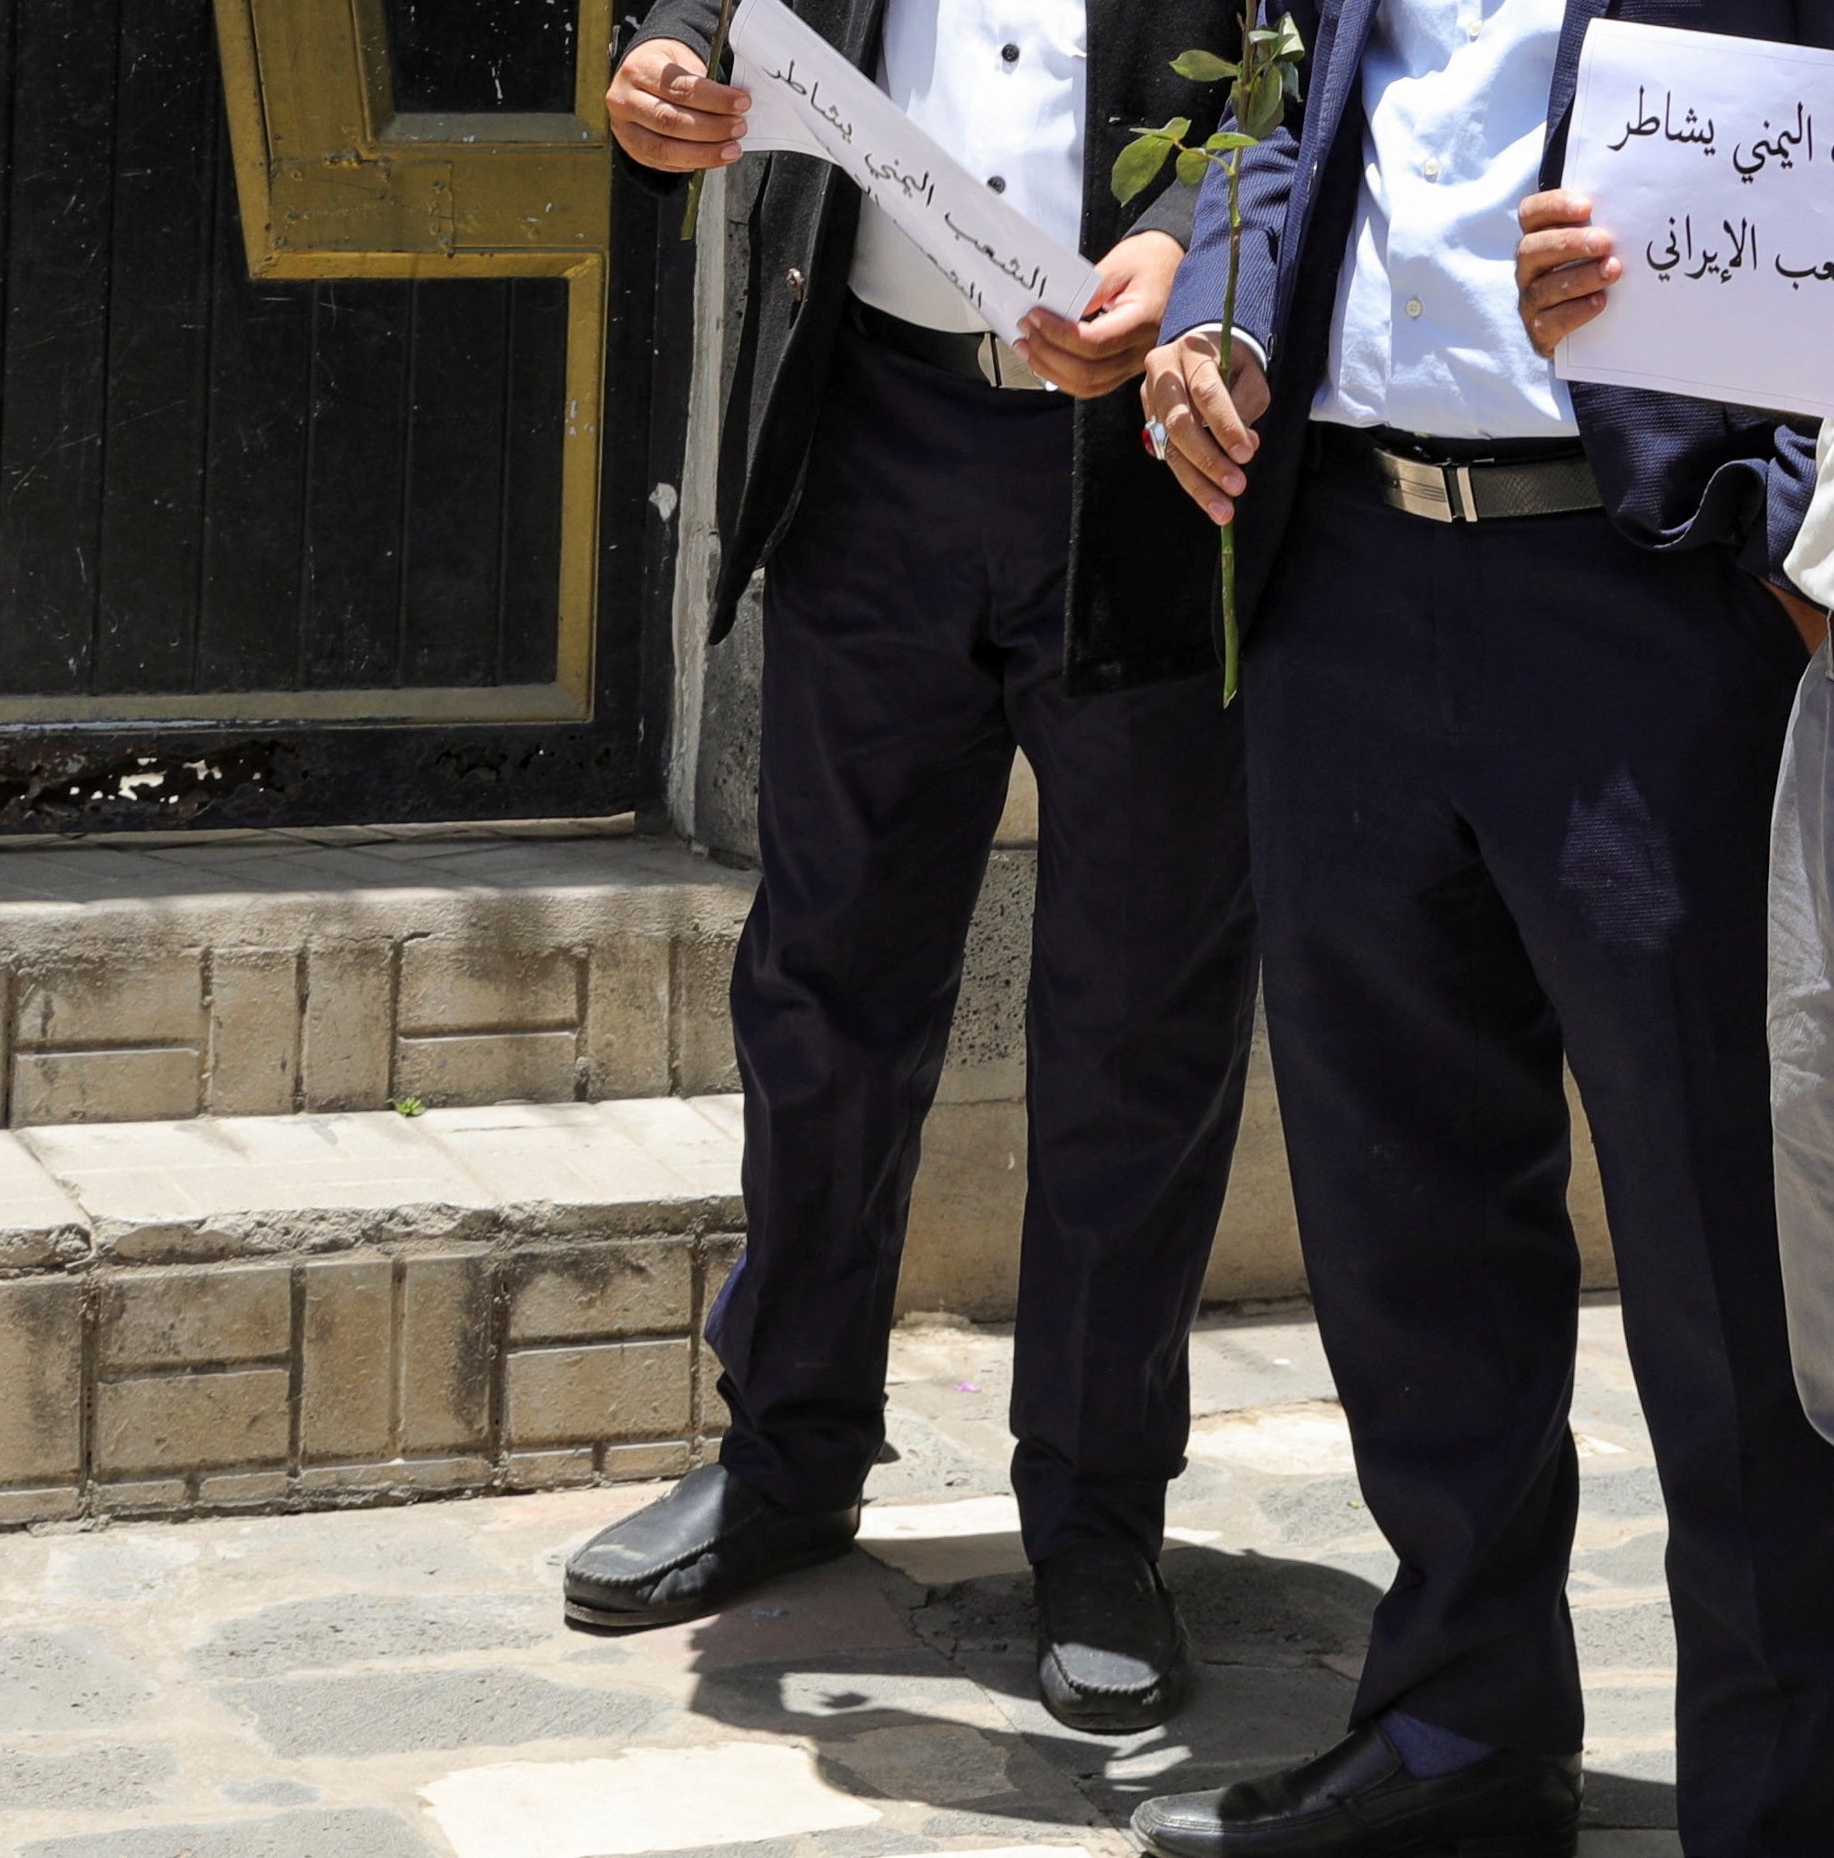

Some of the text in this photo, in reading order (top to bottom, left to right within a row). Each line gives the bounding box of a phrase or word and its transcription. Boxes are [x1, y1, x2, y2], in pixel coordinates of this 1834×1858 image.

[761, 58, 853, 144] يشاطر
[1607, 85, 1716, 156] يشاطر
[864, 152, 936, 208] اليمني
[1732, 101, 1814, 183] اليمني
[944, 211, 1048, 300] الشعب
[1646, 213, 1759, 283] الإيراني
